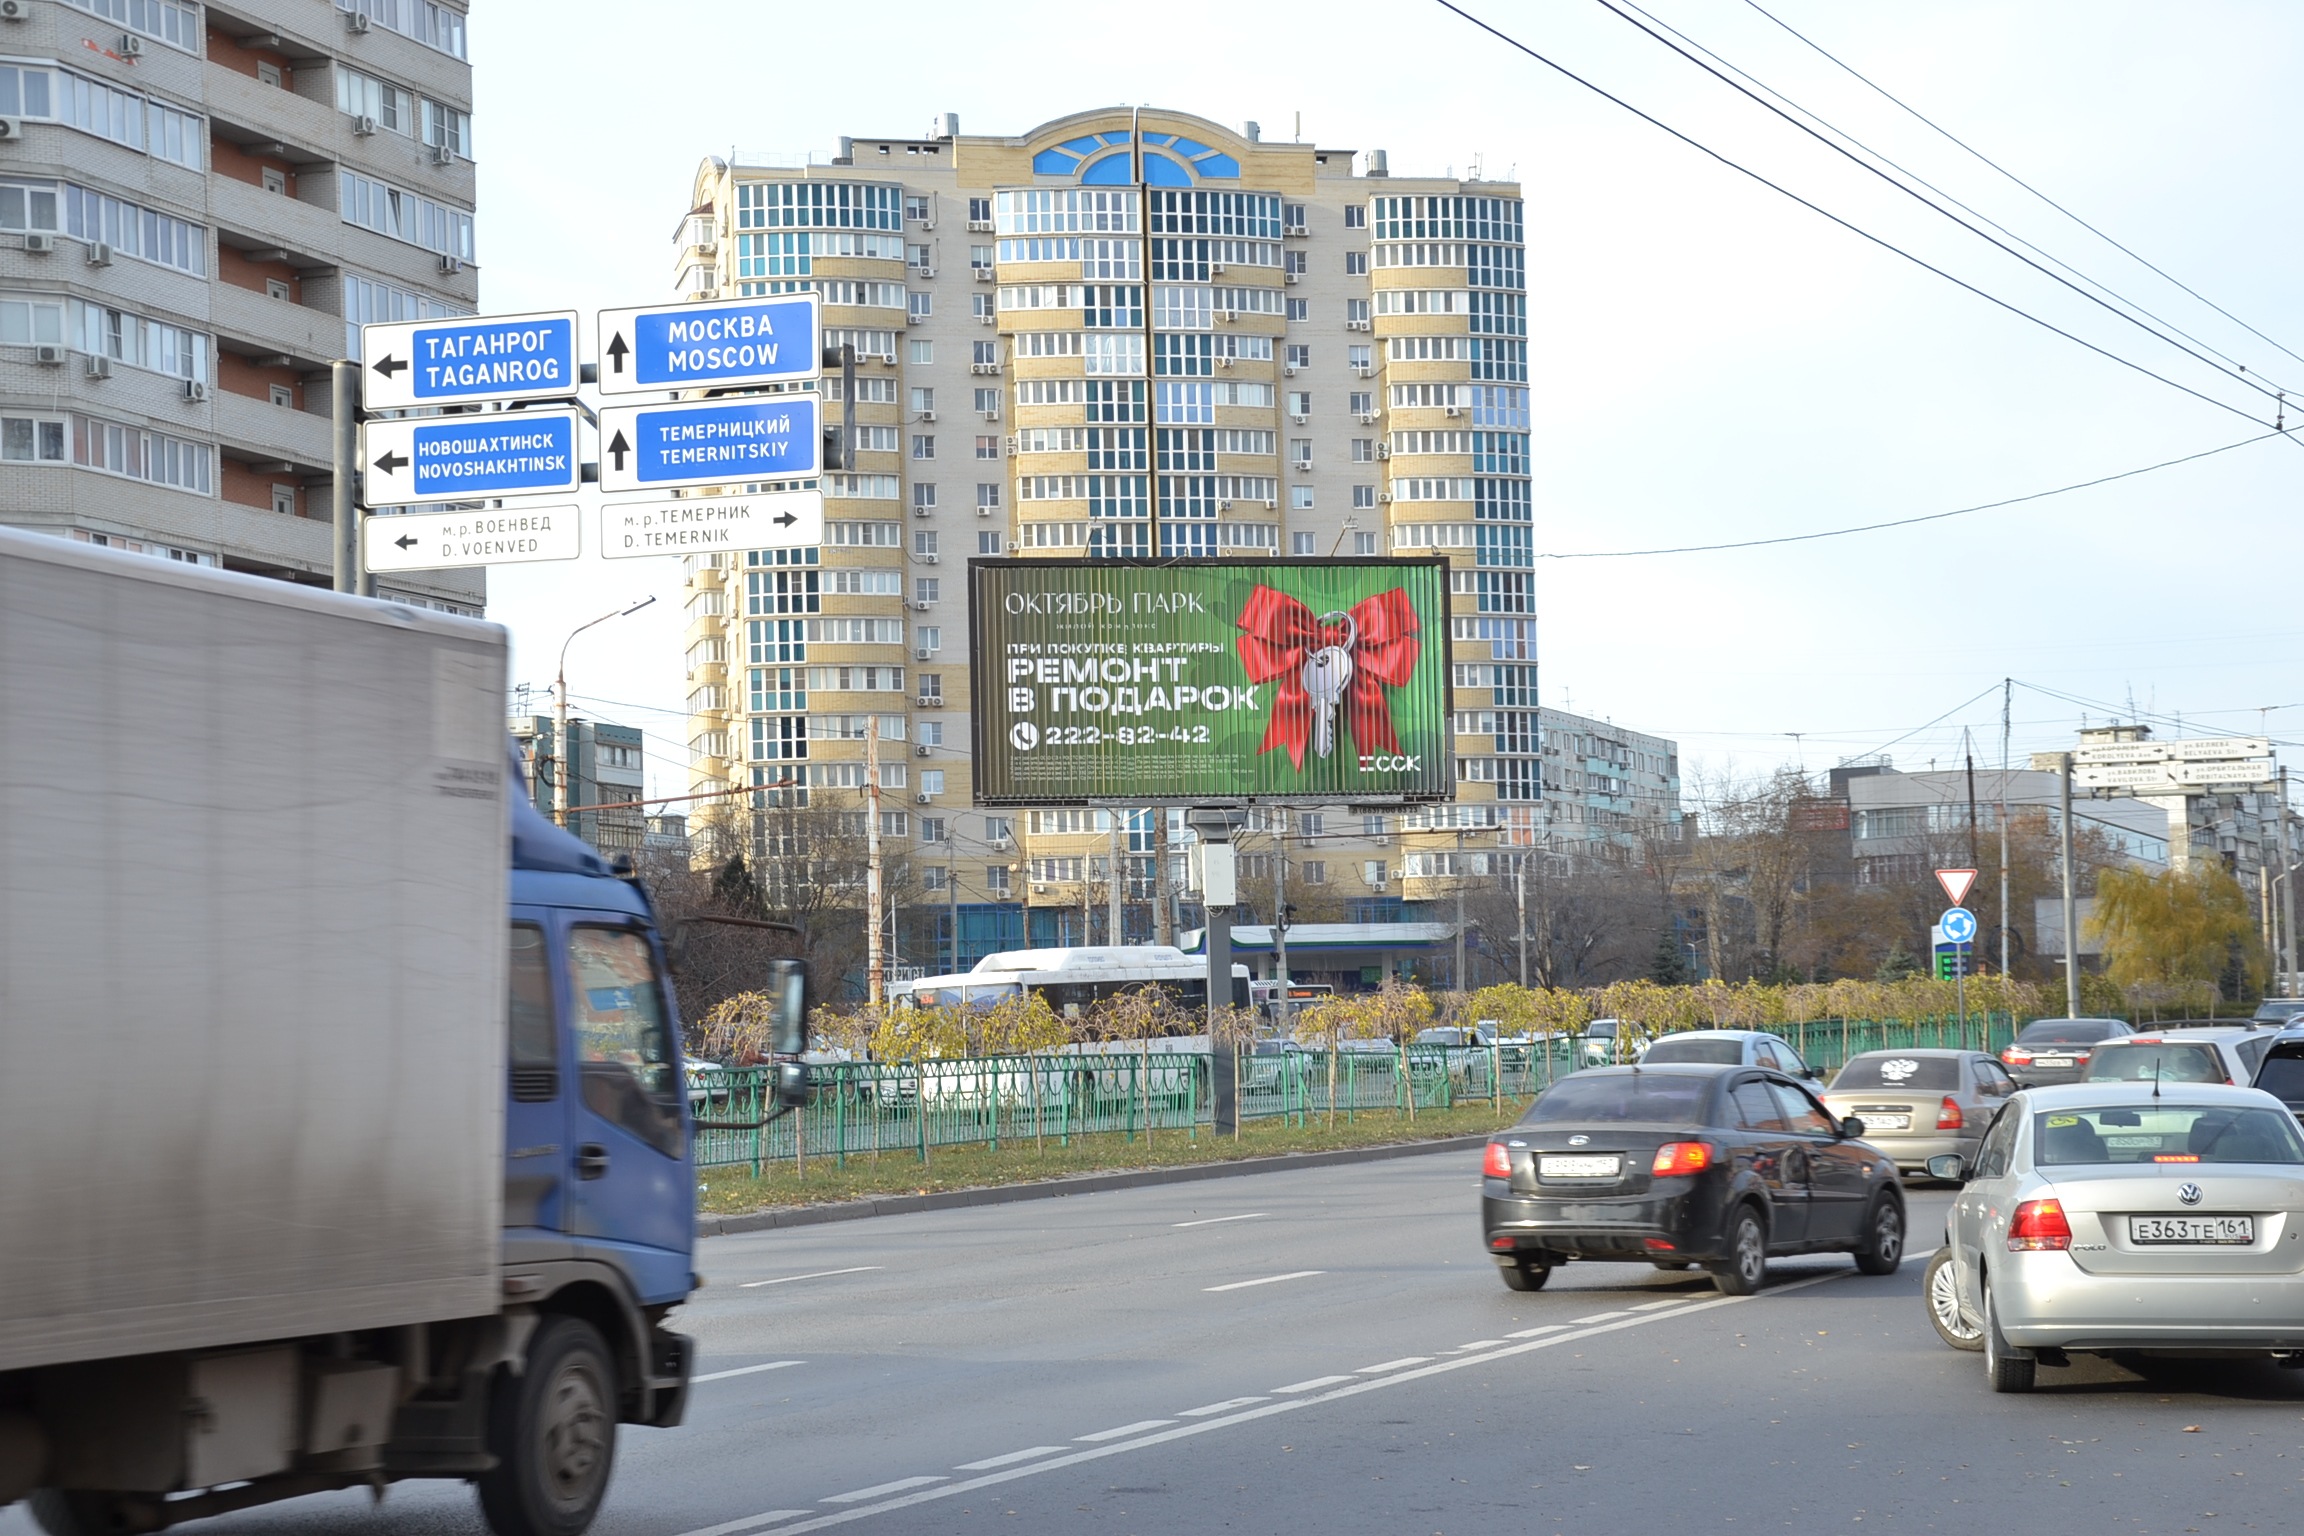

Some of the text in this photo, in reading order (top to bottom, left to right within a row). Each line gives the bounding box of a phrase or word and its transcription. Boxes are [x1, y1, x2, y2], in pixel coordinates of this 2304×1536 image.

[668, 314, 774, 344] МОСКВА
[426, 328, 553, 360] ТАГАНРОГ
[668, 342, 779, 373] MOSCOW
[426, 357, 560, 389] TAGANROG
[659, 414, 791, 443] ТЕМЕРНИЦКИЙ
[418, 432, 554, 458] НОВОШАХТИНСК
[659, 440, 789, 466] TEMERNITSKIY
[418, 454, 566, 480] NOVOSHAKHTINSK
[442, 538, 538, 557] D. VOENVED
[624, 528, 729, 548] D. TEMERNIK
[1005, 591, 1206, 615] ОКТЯБРЬ ПАРК
[1007, 642, 1224, 655] ПРИ ПОКУПКЕ КВАРТИРЫ
[1007, 657, 1188, 684] РЕМОНТ
[1008, 685, 1260, 716] В ПОДАРОК
[1046, 725, 1211, 746] 222-82-42
[2139, 1219, 2247, 1239] Е363ТЕ 161
[2073, 1243, 2107, 1252] POLO
